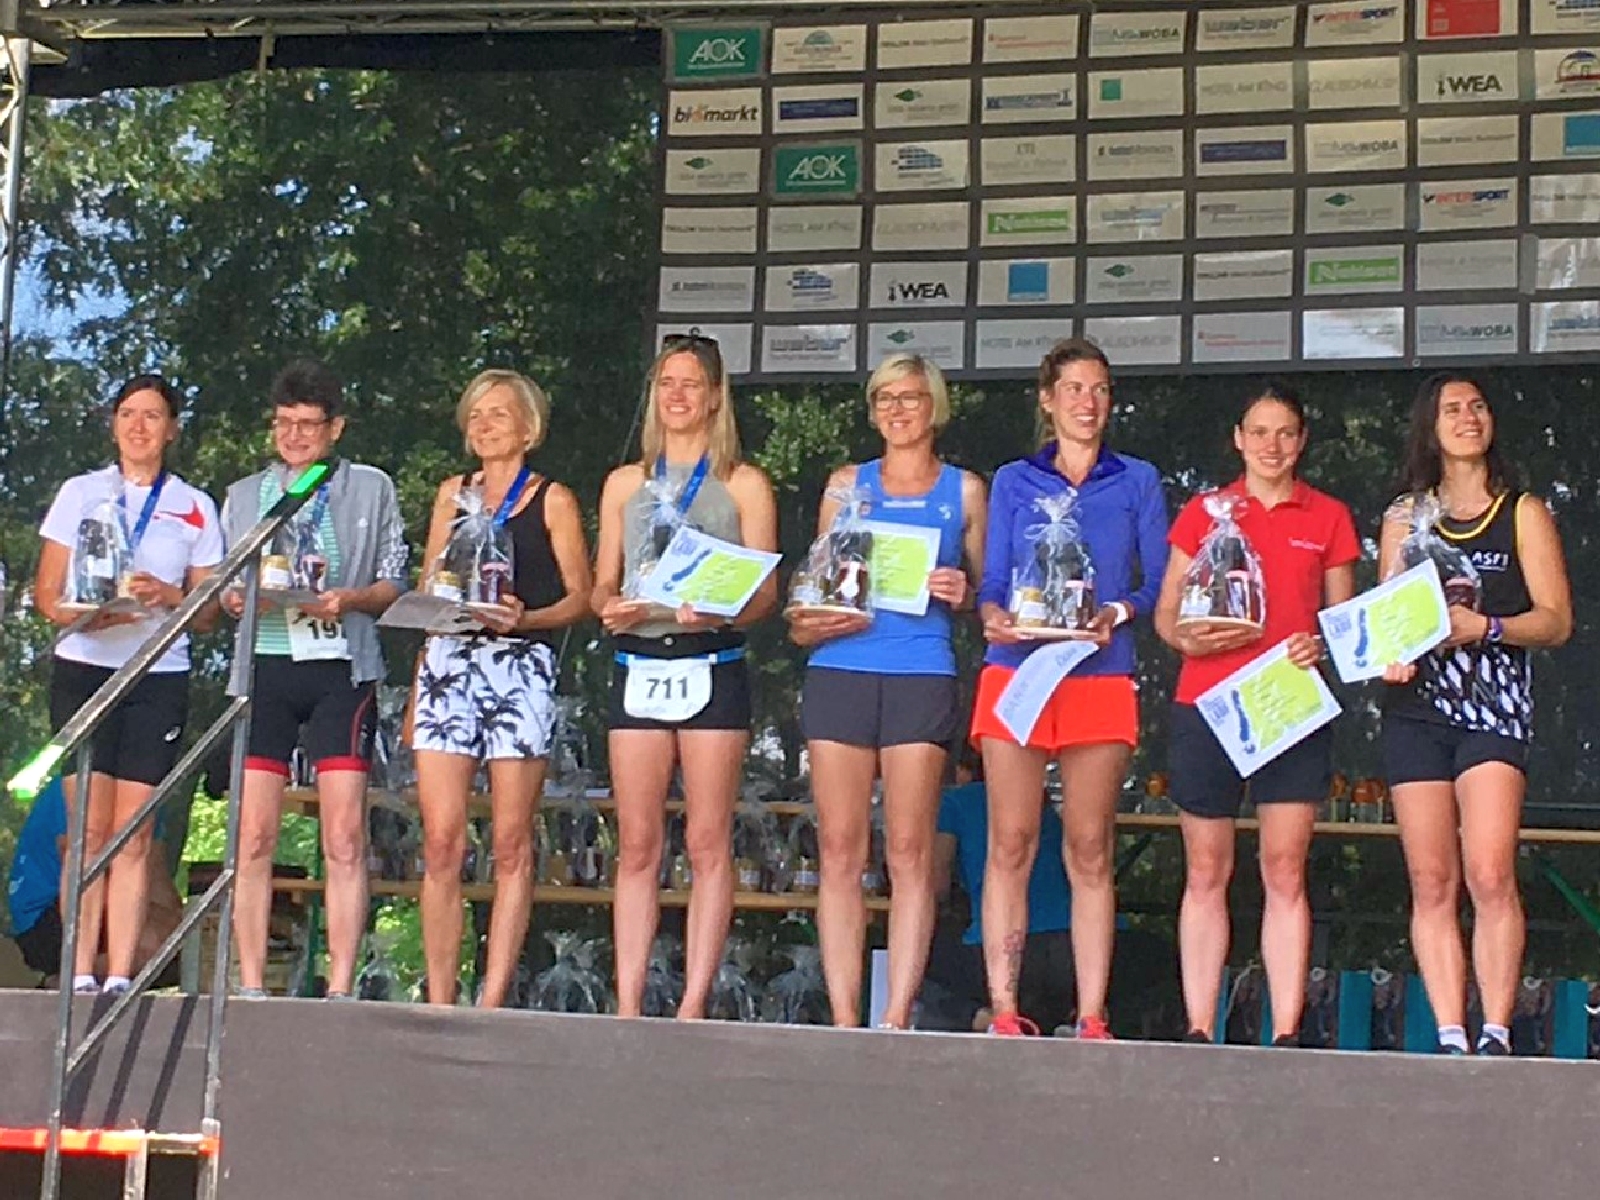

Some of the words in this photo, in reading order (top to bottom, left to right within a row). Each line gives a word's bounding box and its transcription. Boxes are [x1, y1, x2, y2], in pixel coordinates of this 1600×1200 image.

[688, 38, 746, 62] AOK
[675, 104, 760, 123] biomarkt
[788, 154, 847, 180] AOK
[307, 618, 346, 640] 19
[646, 676, 688, 699] 711
